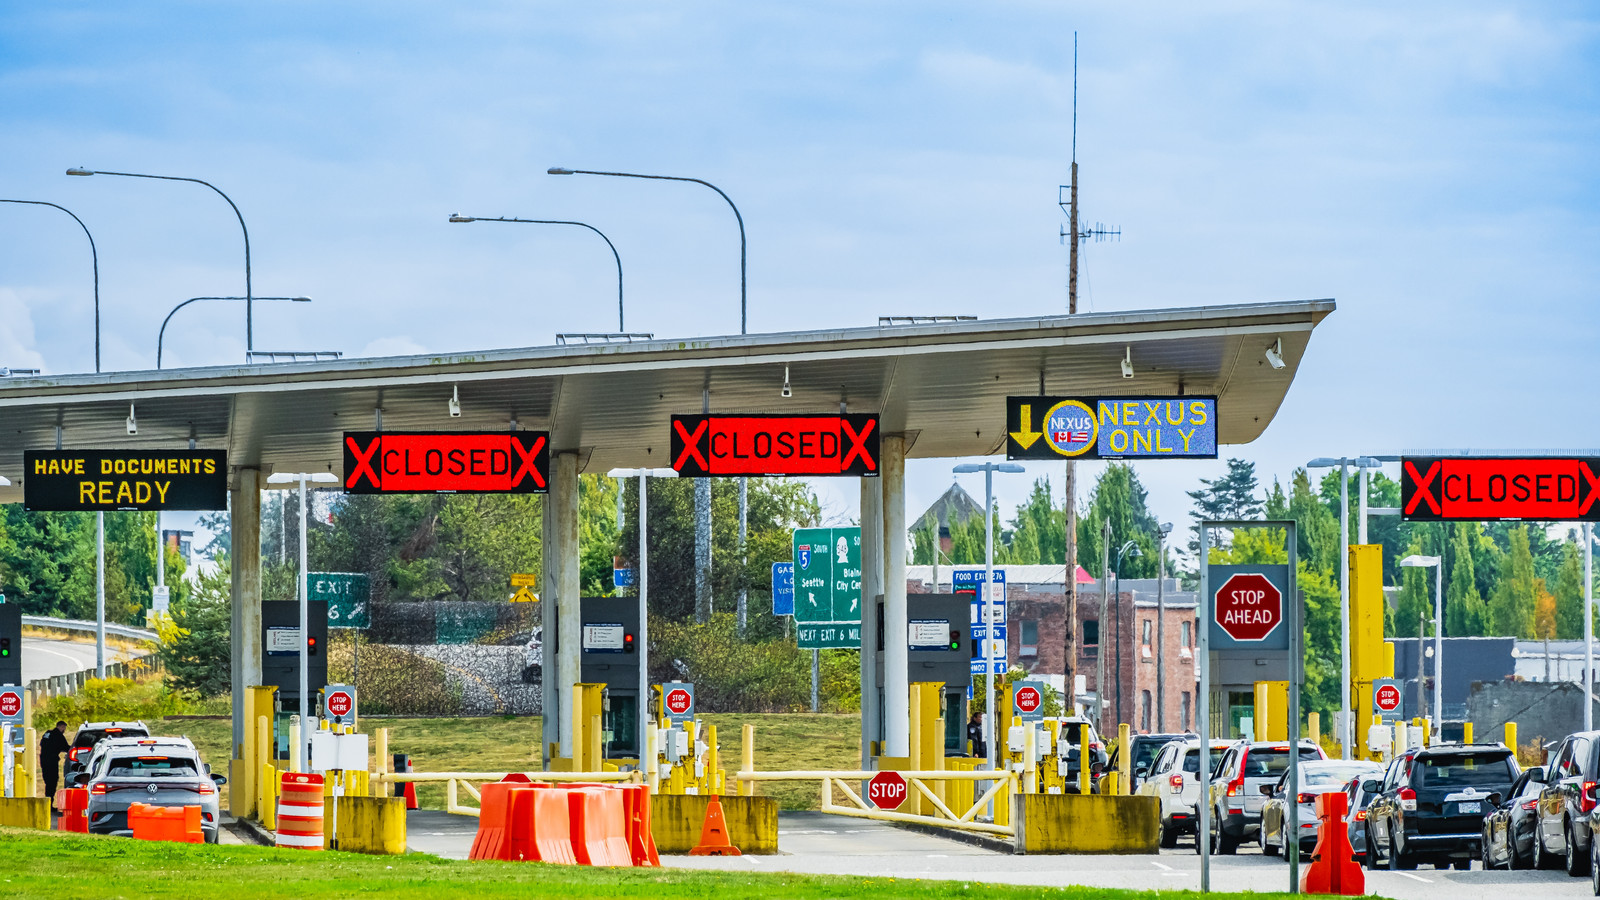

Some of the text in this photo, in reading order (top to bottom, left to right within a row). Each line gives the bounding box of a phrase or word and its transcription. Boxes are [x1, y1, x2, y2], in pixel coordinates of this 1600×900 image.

[1100, 402, 1207, 426] NEXUS
[1051, 417, 1092, 430] NEXUS
[710, 432, 838, 458] CLOSED
[1110, 429, 1196, 453] ONLY
[34, 458, 216, 475] HAVE DOCUMENTS
[383, 448, 509, 476] CLOSED
[80, 480, 171, 504] READY
[1444, 474, 1576, 502] CLOSED
[802, 552, 808, 567] 5
[802, 578, 824, 588] Seattle
[955, 572, 972, 581] FOOD
[316, 580, 352, 594] EXIT
[837, 581, 848, 592] City
[1231, 590, 1266, 605] STOP
[1224, 610, 1272, 624] AHEAD
[799, 629, 816, 640] NEXT
[821, 629, 835, 641] EXIT
[840, 630, 844, 640] 6
[870, 783, 905, 798] STOP
